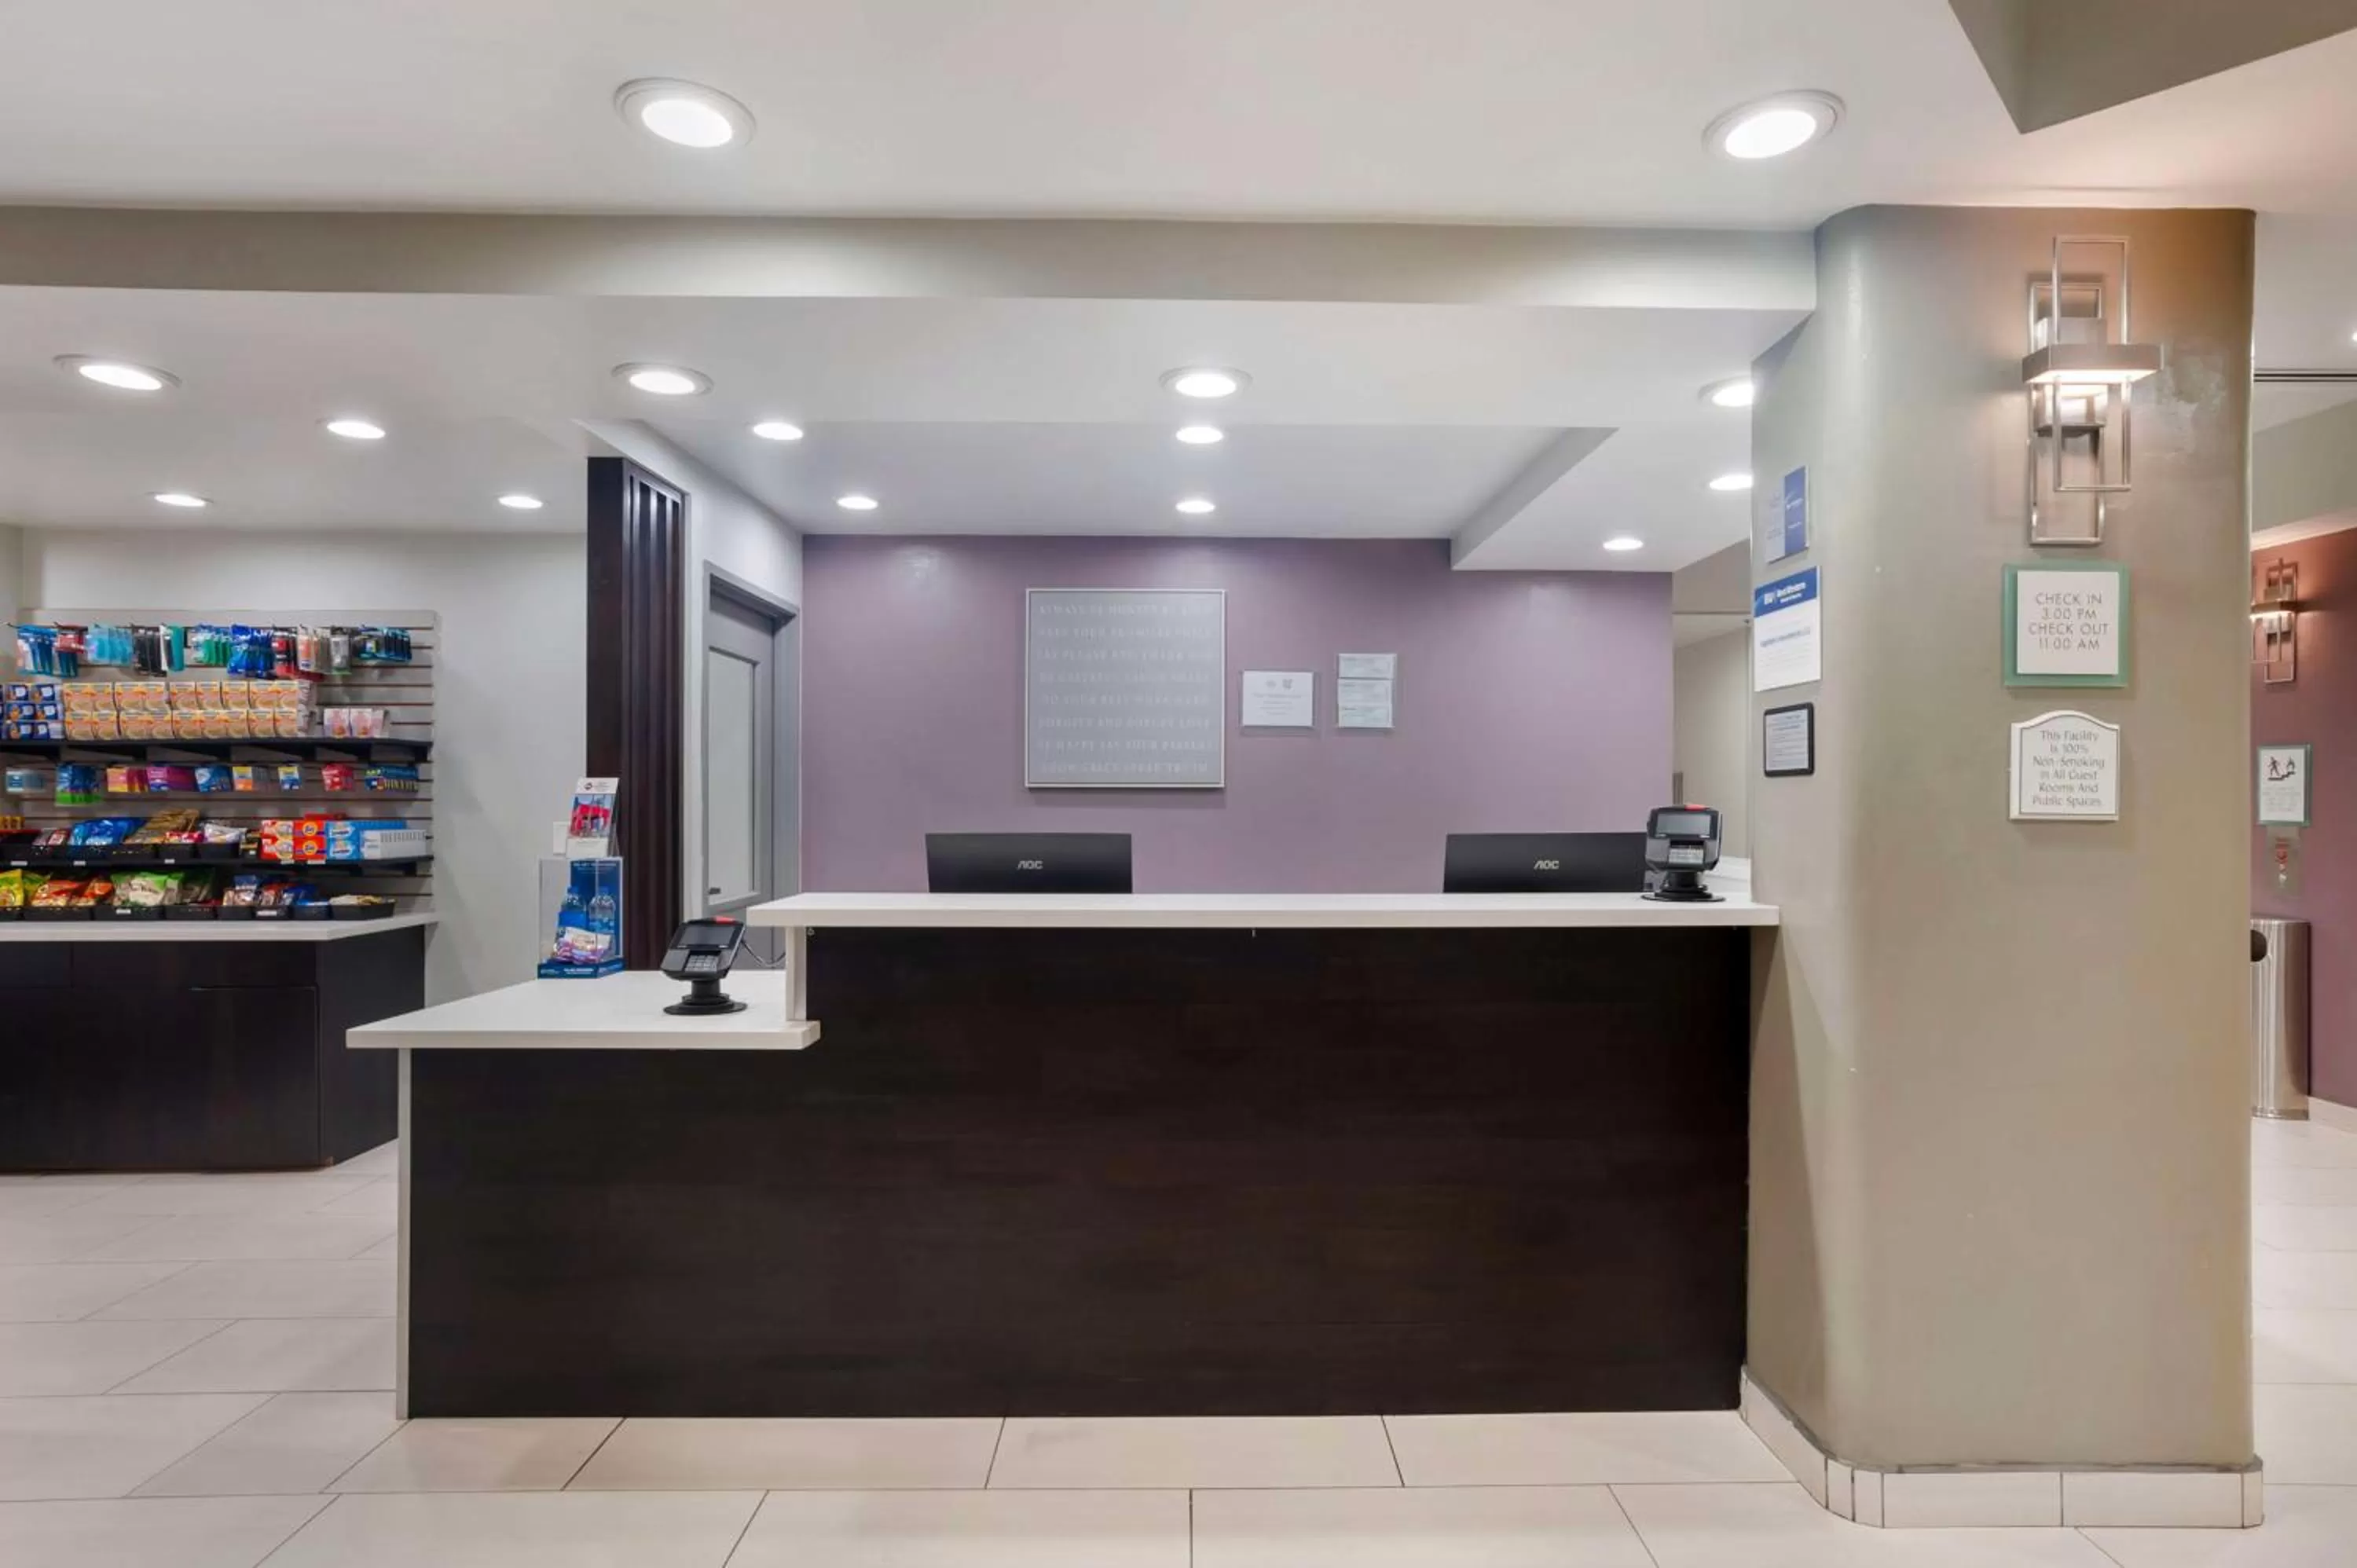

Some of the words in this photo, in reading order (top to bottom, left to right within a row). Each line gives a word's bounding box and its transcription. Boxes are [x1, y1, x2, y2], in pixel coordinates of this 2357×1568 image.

[2035, 592, 2080, 606] CHECK
[2087, 592, 2102, 604] IN
[2077, 607, 2097, 620] PM
[2028, 622, 2074, 636] CHECK
[2080, 622, 2110, 636] OUT
[2077, 637, 2100, 650] AM
[2039, 729, 2061, 741] This
[2064, 729, 2099, 742] Facility
[2068, 769, 2099, 781] Guest
[2038, 782, 2075, 793] Rooms
[2077, 782, 2099, 793] And
[2033, 794, 2063, 806] Public
[1017, 860, 1043, 870] AOC
[1534, 860, 1560, 870] AOC
